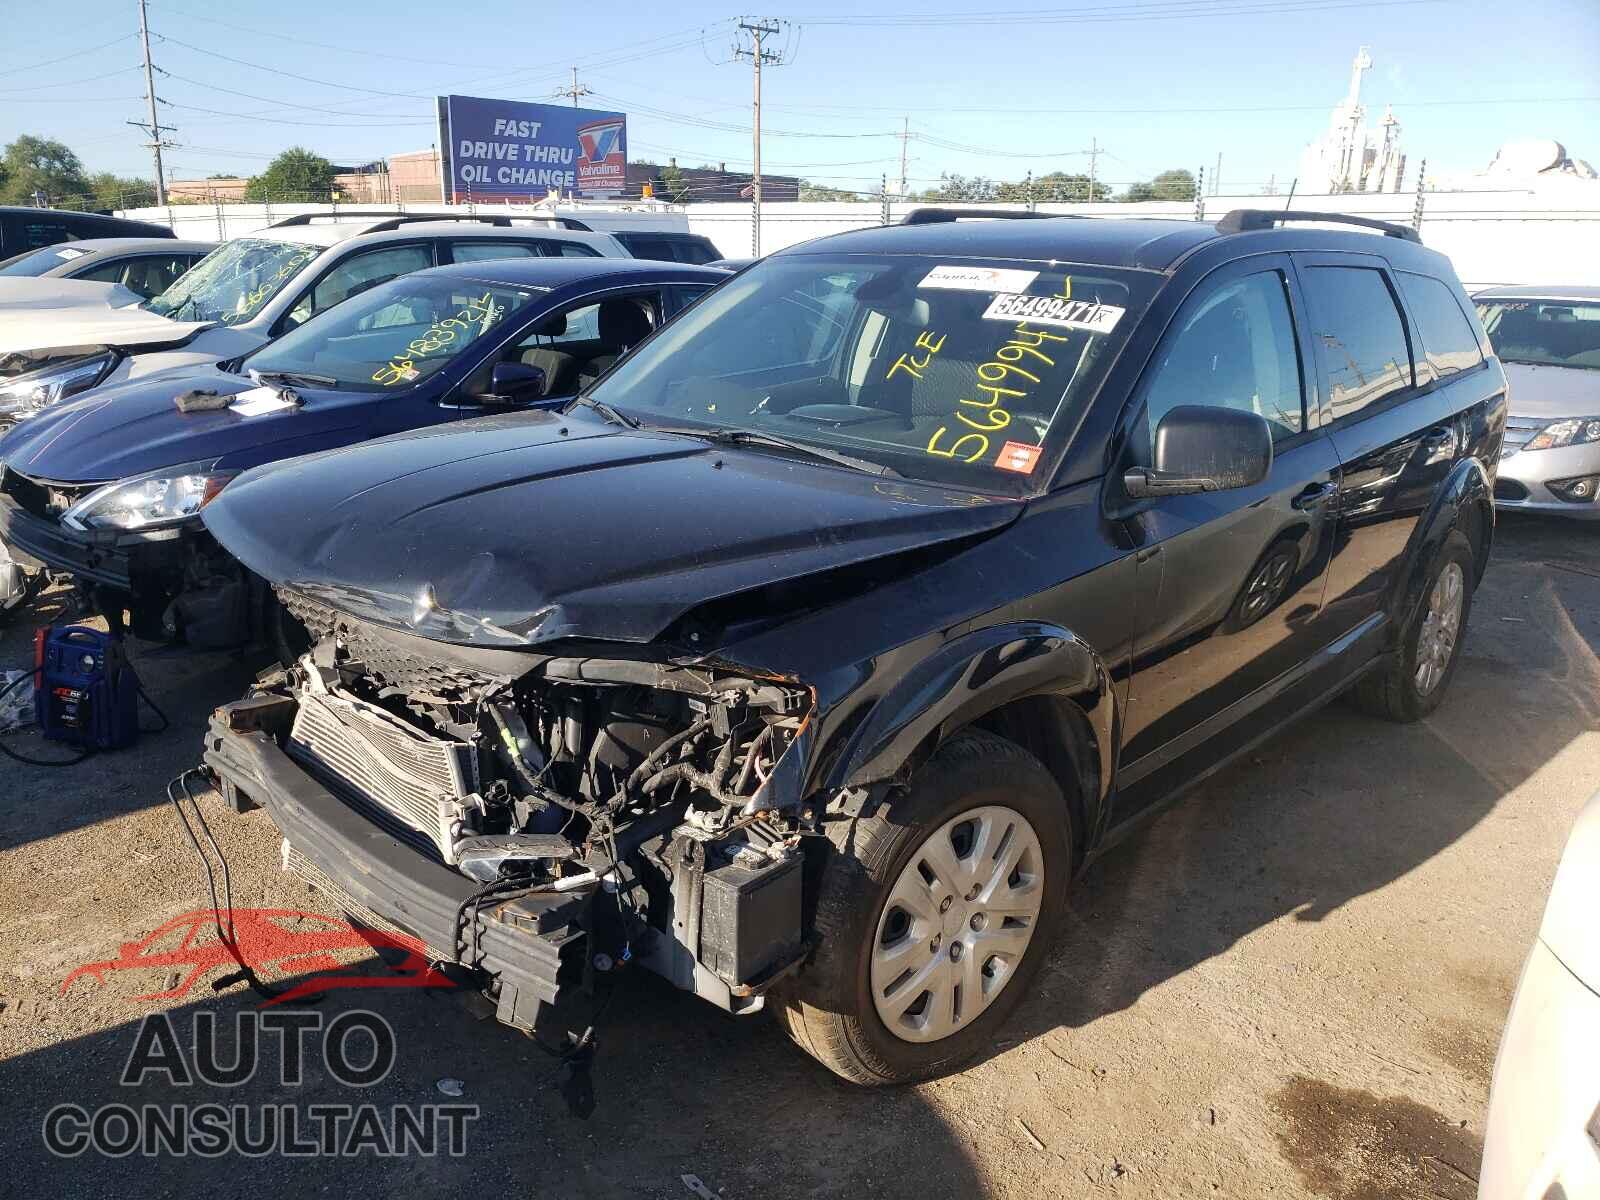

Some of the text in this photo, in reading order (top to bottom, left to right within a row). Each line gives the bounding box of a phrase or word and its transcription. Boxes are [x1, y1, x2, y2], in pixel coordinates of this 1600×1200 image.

[494, 119, 541, 138] FAST
[460, 140, 574, 165] DRIVE THRU
[461, 164, 575, 187] OIL CHANGE
[579, 163, 620, 176] Valvoline
[994, 294, 1098, 325] 56499471
